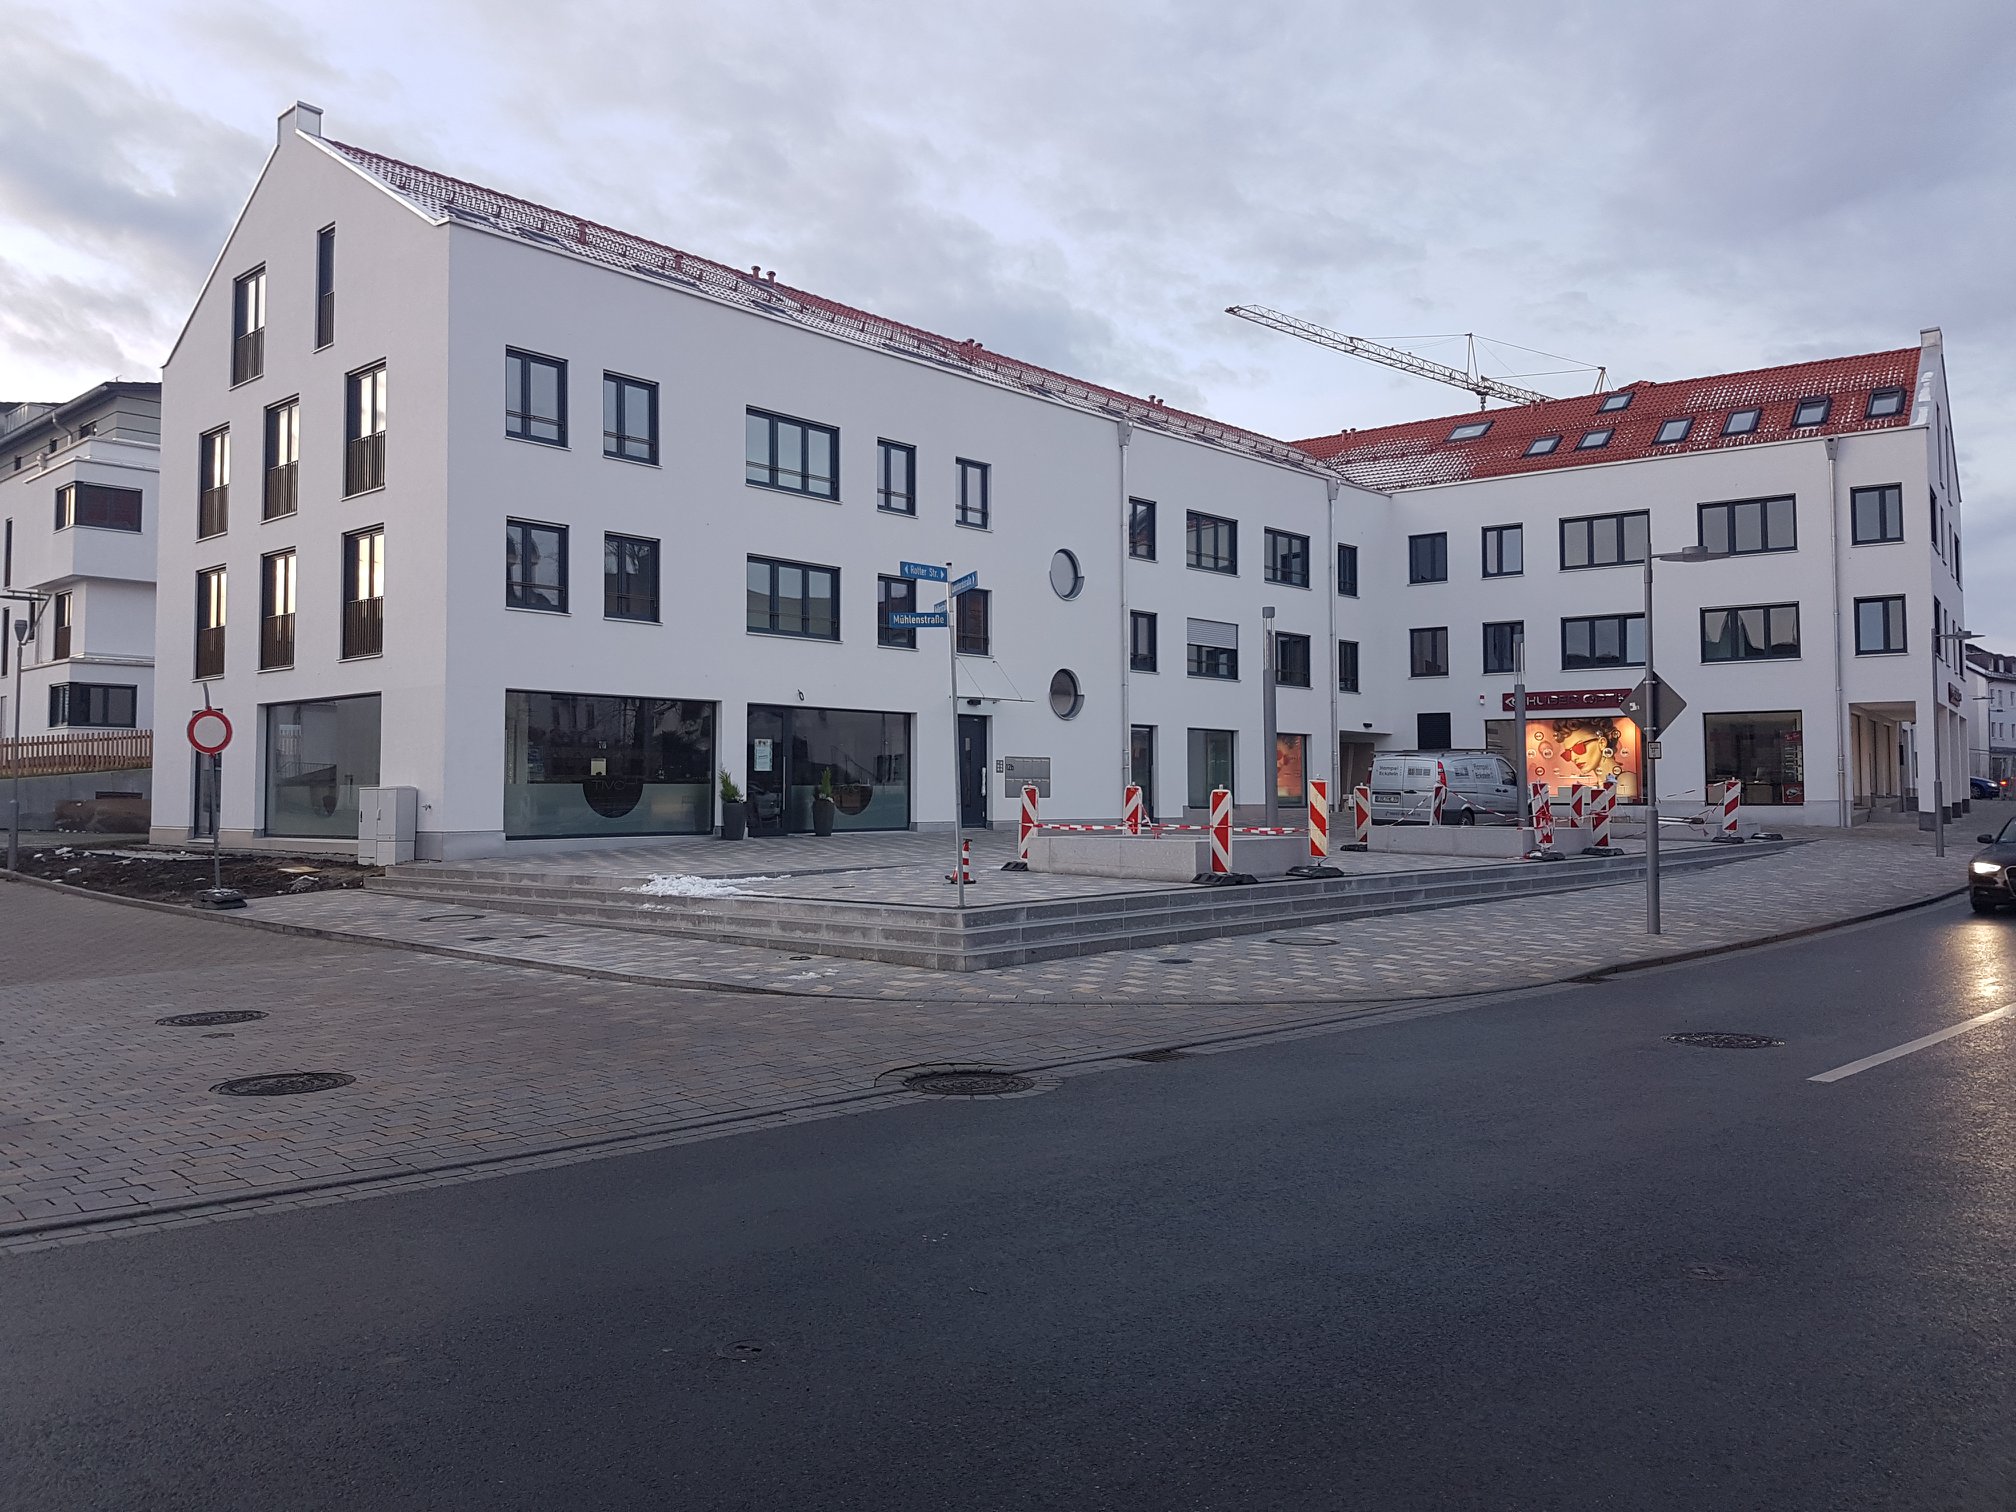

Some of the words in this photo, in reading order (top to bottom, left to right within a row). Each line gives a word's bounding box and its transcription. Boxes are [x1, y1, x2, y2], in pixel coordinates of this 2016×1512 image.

[910, 565, 927, 576] Rotter
[929, 568, 939, 578] Str.
[893, 614, 945, 625] Mühlenstraße
